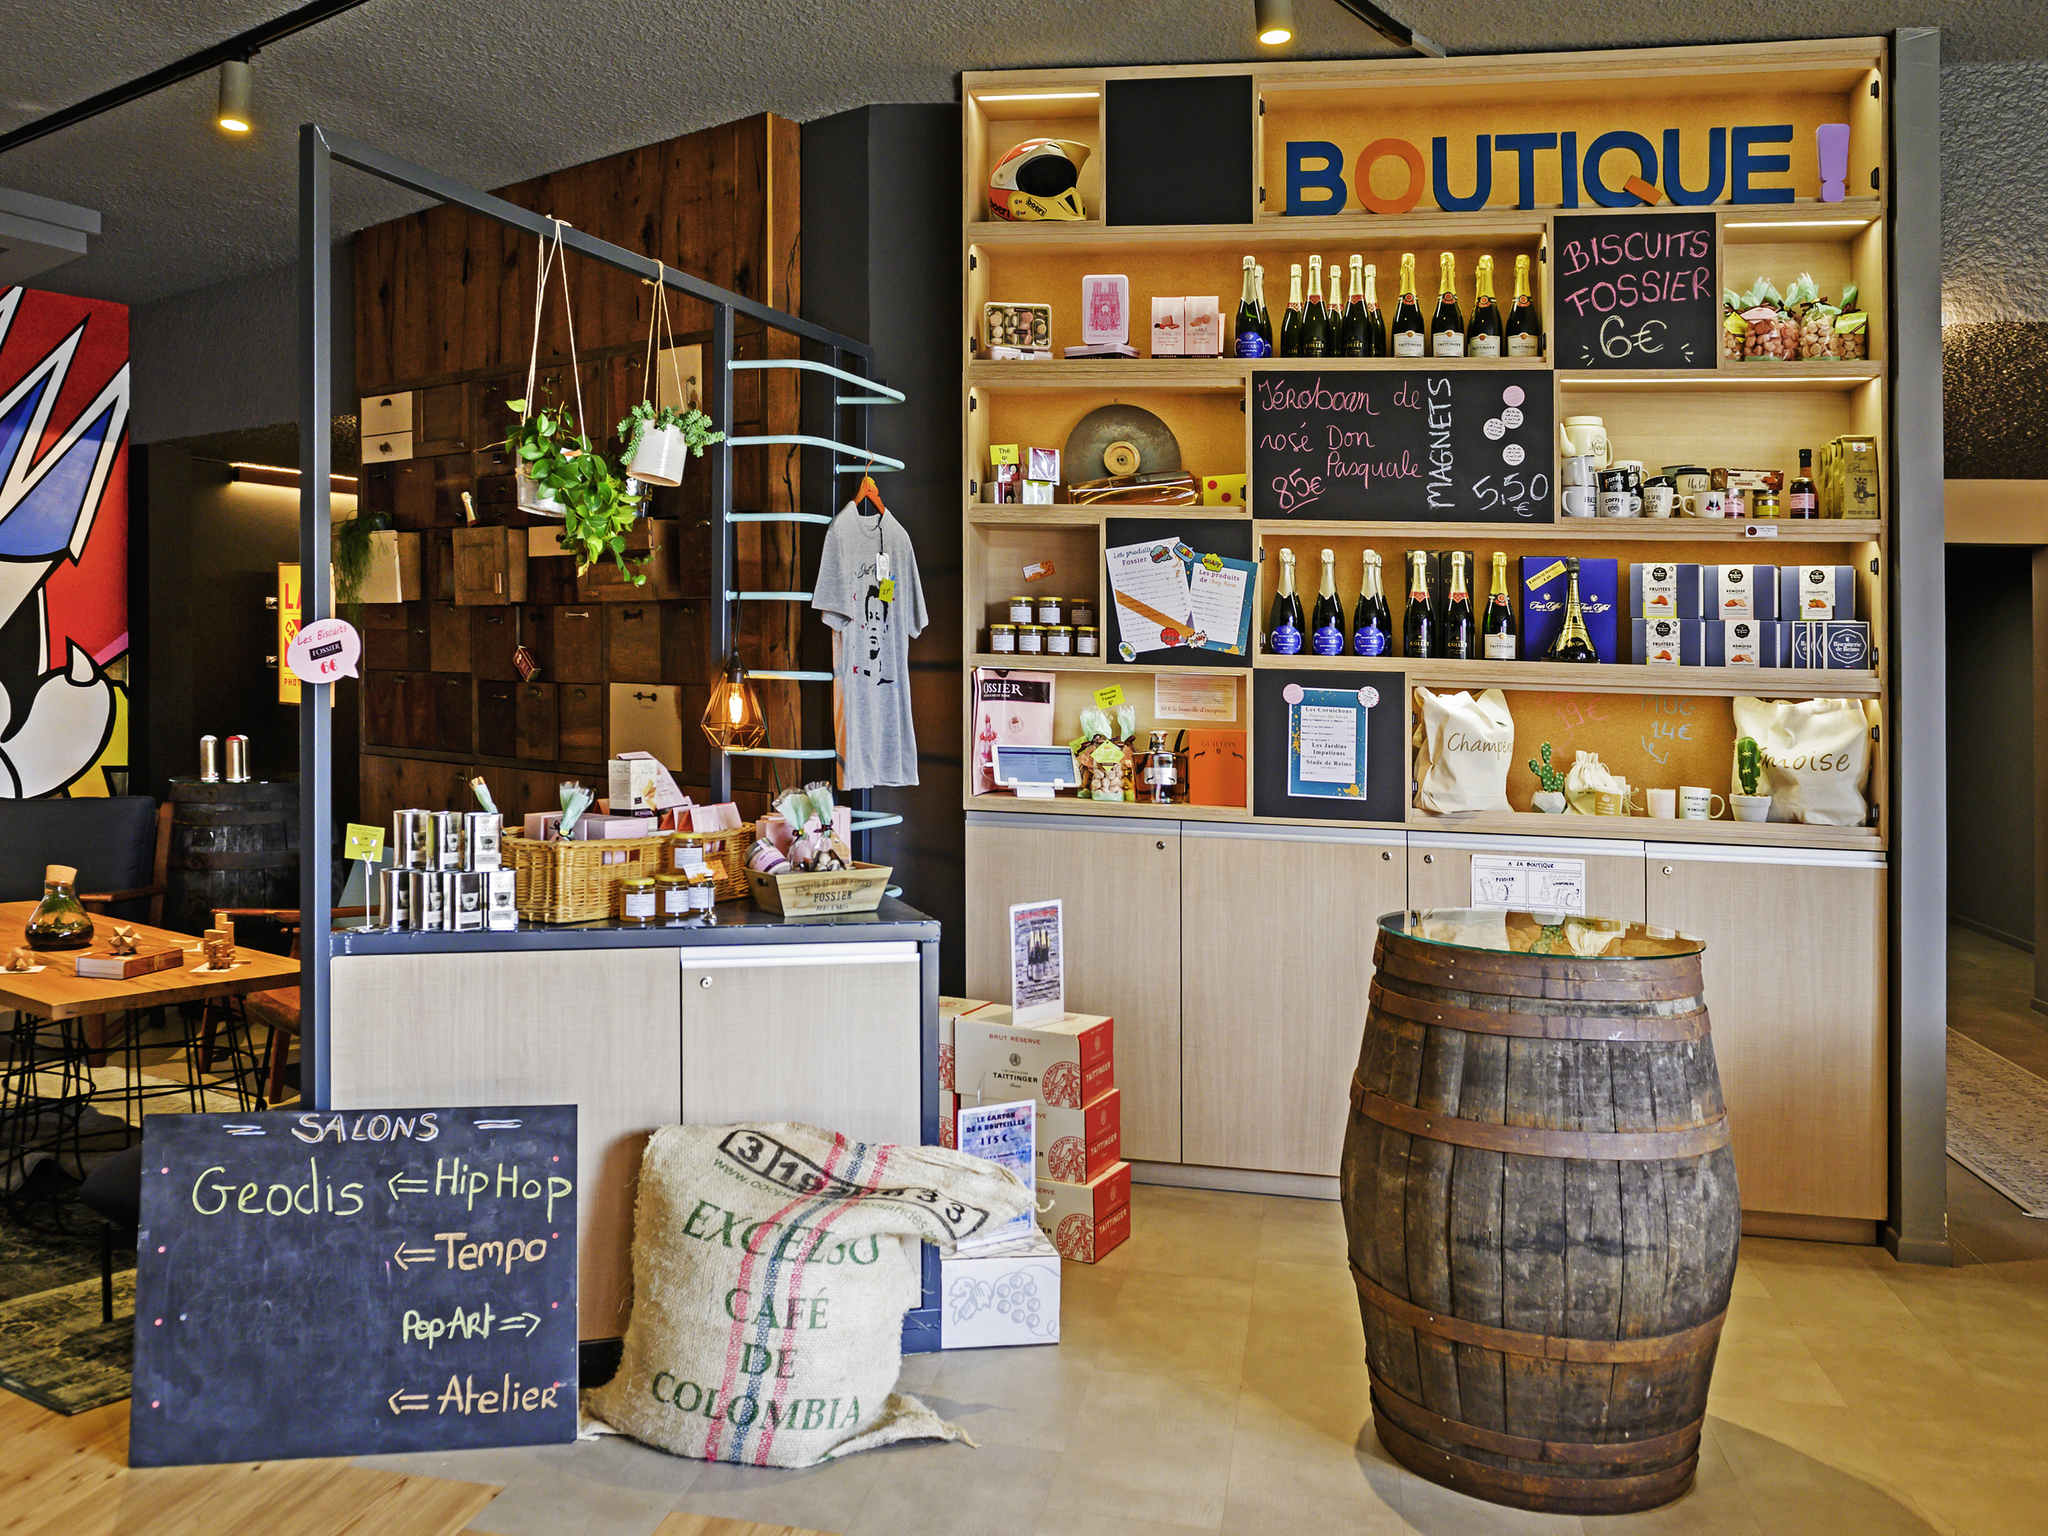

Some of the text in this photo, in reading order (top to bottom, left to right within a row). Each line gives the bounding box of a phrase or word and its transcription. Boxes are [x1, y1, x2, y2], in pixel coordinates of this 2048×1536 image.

[1286, 124, 1795, 216] BOUTIQUE
[1563, 230, 1712, 276] BISCUITS
[1564, 266, 1712, 317] FOSSIER
[1599, 314, 1668, 359] 6€
[1393, 380, 1423, 411] de
[1260, 421, 1376, 453] rosé Don
[1426, 376, 1456, 509] MAGNETS
[1271, 468, 1327, 510] 85€
[1326, 450, 1423, 489] Pasquale
[1472, 472, 1549, 510] 5,50
[1511, 501, 1535, 518] €
[297, 624, 348, 646] Les Biscuits
[320, 658, 338, 675] 6€
[983, 682, 1024, 696] OSSIER
[1651, 720, 1696, 741] 14€
[814, 890, 853, 903] FOSSIER
[989, 1033, 1008, 1041] BRUT
[992, 1071, 1039, 1084] TAITTINGER
[292, 1113, 439, 1143] SALONS
[738, 1136, 764, 1163] 3
[192, 1157, 573, 1223] Geodis Hip Hop
[682, 1200, 880, 1266] EXCELSO
[434, 1232, 547, 1275] Tempo
[725, 1287, 829, 1330] CAFÉ
[740, 1342, 799, 1379] DE
[652, 1370, 861, 1431] COLOMBIA
